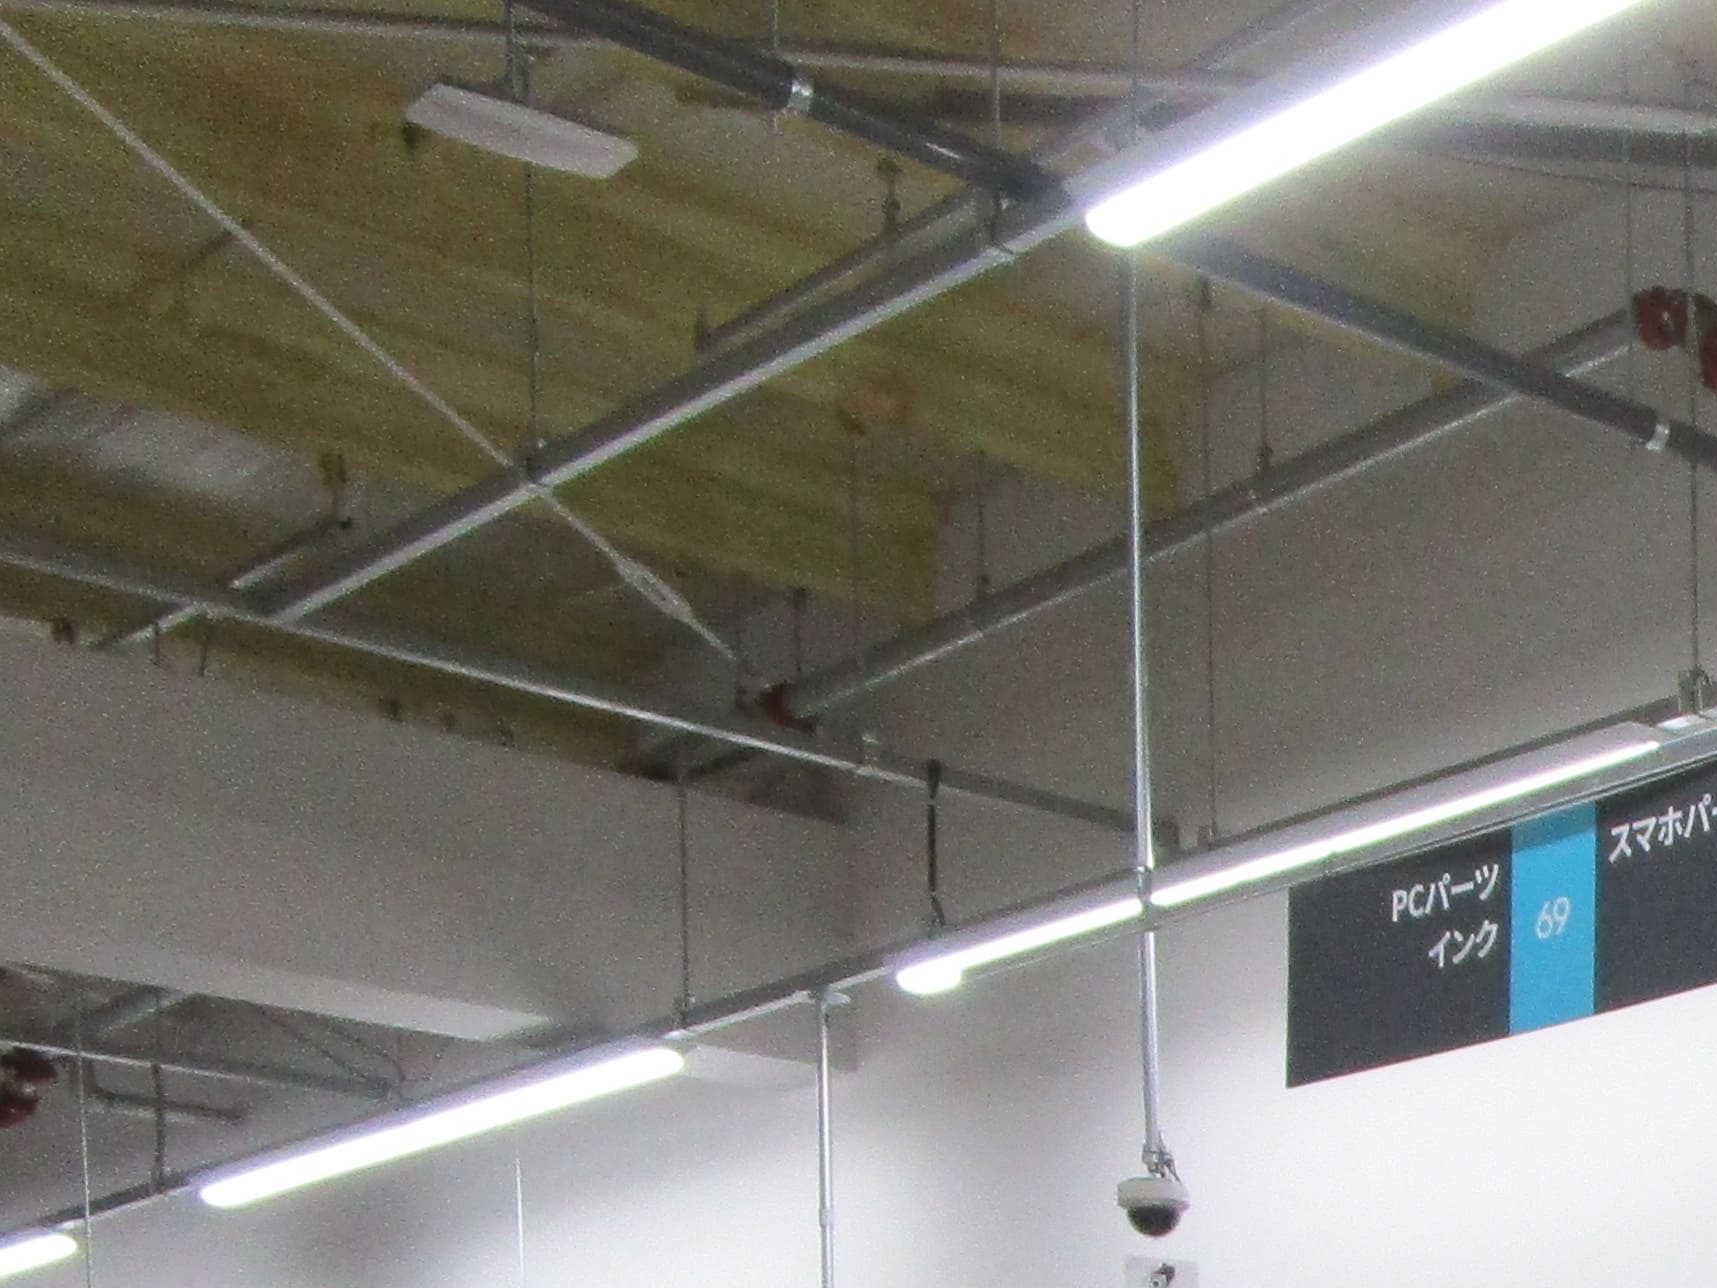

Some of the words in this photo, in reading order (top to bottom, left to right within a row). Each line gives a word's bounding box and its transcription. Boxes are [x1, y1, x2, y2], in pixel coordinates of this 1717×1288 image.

[1392, 863, 1500, 922] PCパーツ
[1535, 896, 1570, 940] 69
[1428, 920, 1498, 969] インク
